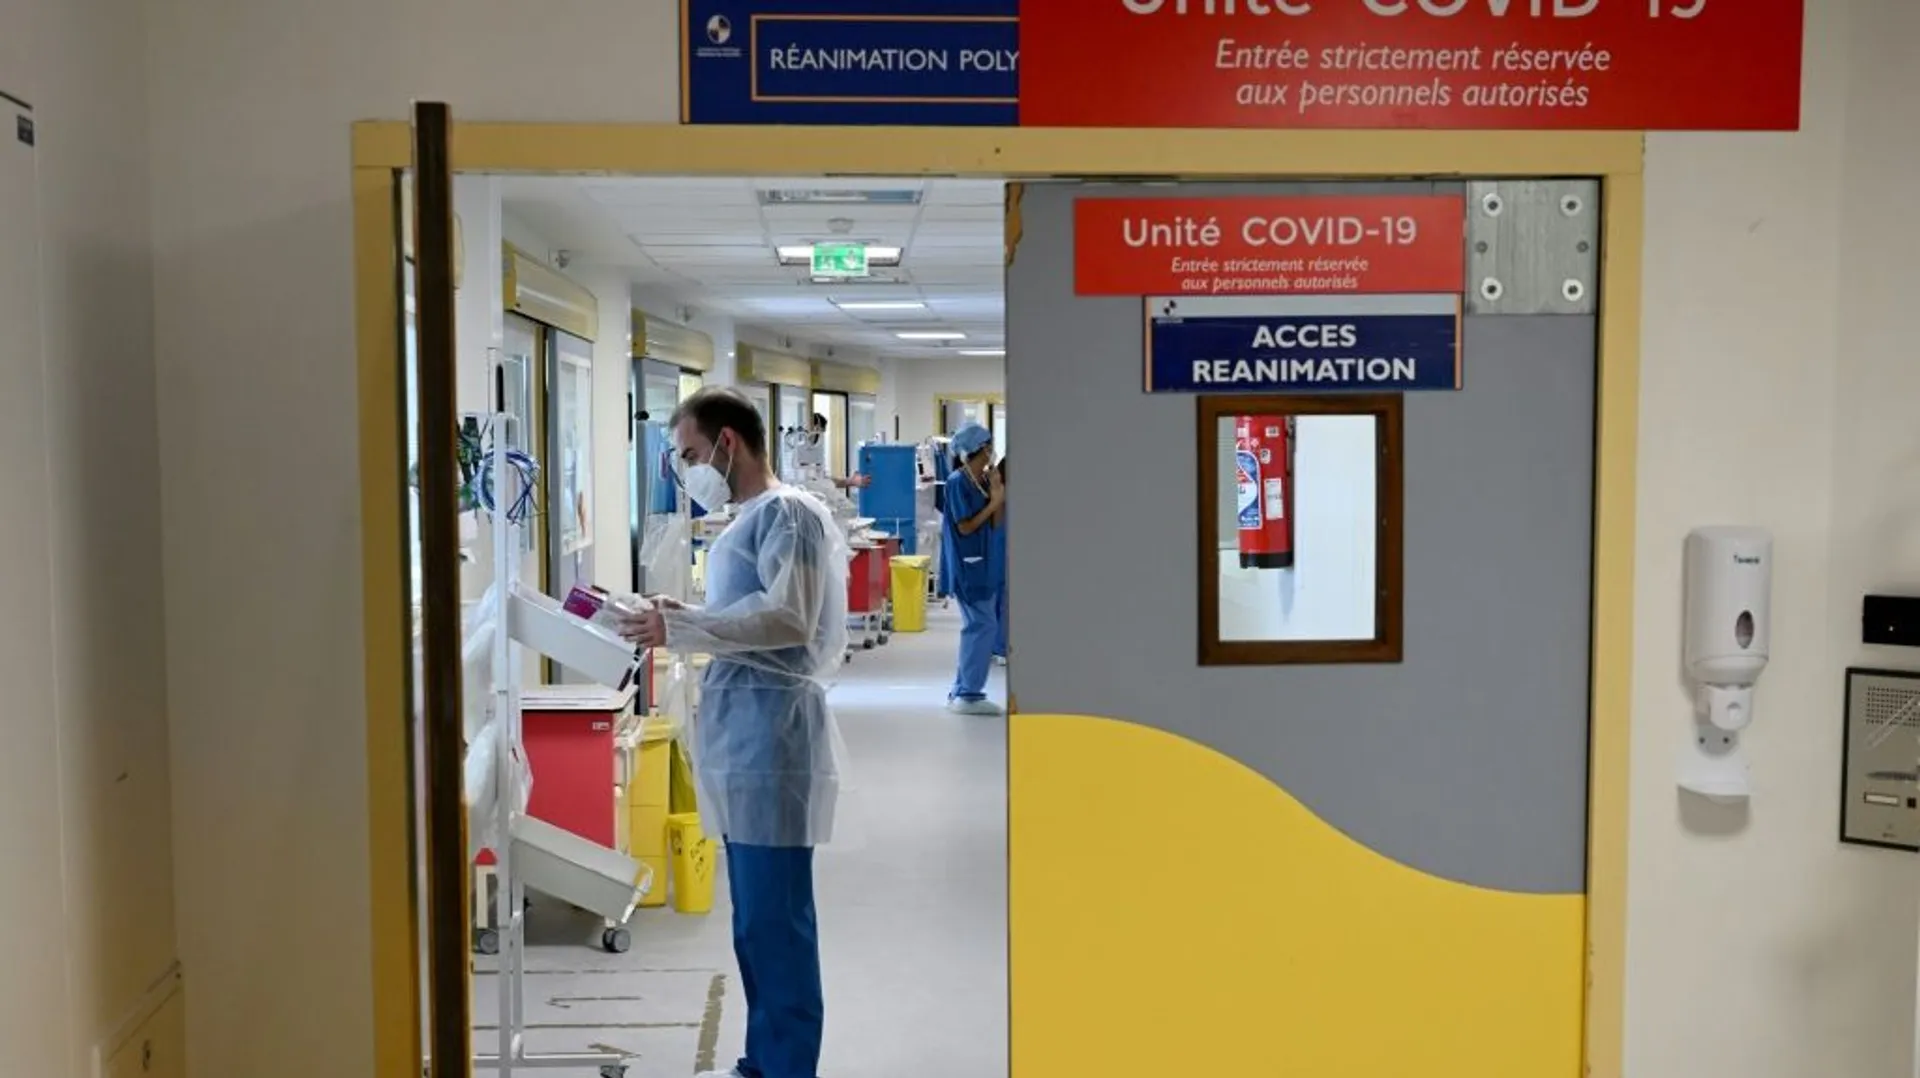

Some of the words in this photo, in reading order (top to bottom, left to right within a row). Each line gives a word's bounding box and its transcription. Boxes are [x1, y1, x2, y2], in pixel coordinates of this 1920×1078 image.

[769, 42, 949, 71] RÉANIMATION
[959, 48, 1019, 72] POLY
[1215, 38, 1310, 70] Entrée
[1319, 40, 1482, 71] strictement
[1491, 41, 1611, 71] réservée
[1236, 84, 1288, 105] aux
[1298, 77, 1451, 113] personnels
[1462, 79, 1590, 107] autorisés
[1123, 216, 1221, 247] Unité
[1241, 216, 1418, 246] COVID-19
[1171, 256, 1219, 273] Entrée
[1223, 257, 1304, 272] strictement
[1308, 256, 1369, 272] réservée
[1182, 279, 1208, 291] aux
[1212, 274, 1289, 293] personnels
[1293, 274, 1358, 290] autorisés
[1251, 324, 1358, 348] ACCES
[1191, 357, 1417, 383] REANIMATION
